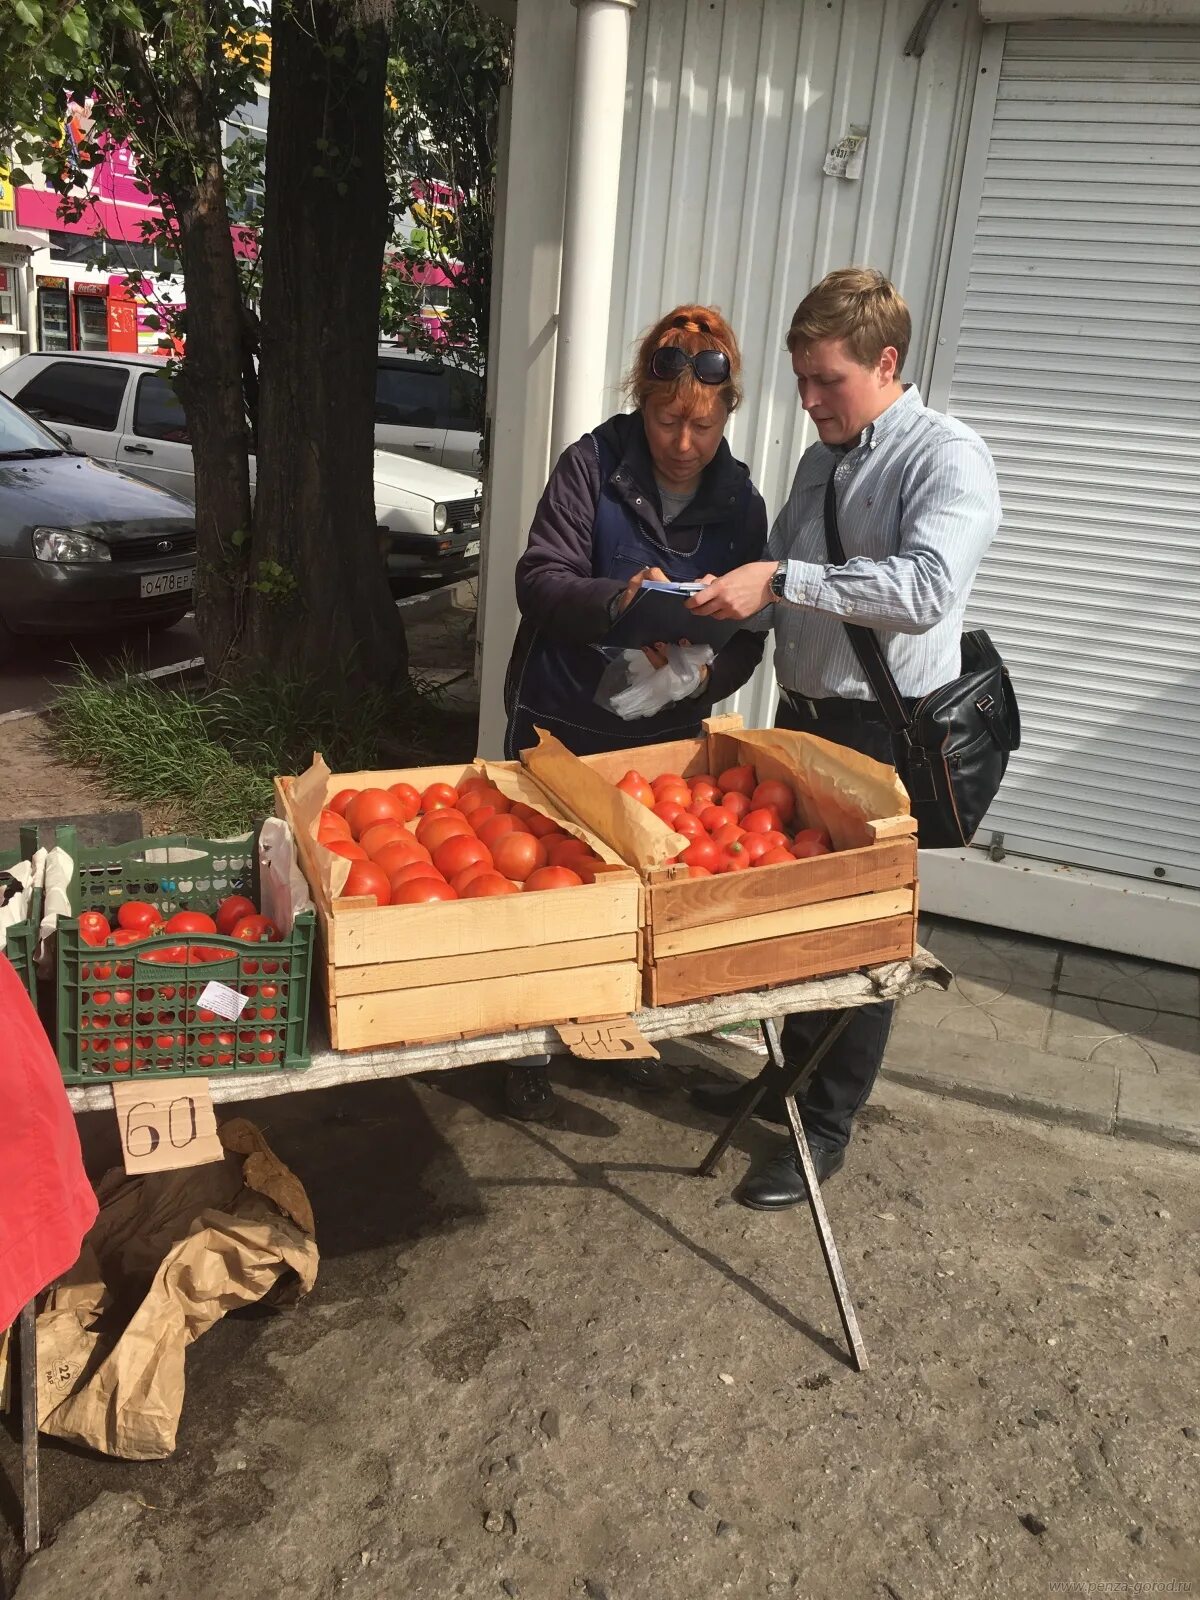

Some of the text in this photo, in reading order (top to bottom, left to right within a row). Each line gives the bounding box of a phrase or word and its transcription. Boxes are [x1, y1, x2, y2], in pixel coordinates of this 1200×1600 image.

[126, 1096, 197, 1158] 60
[46, 1370, 54, 1385] PAP
[58, 1364, 71, 1382] 22
